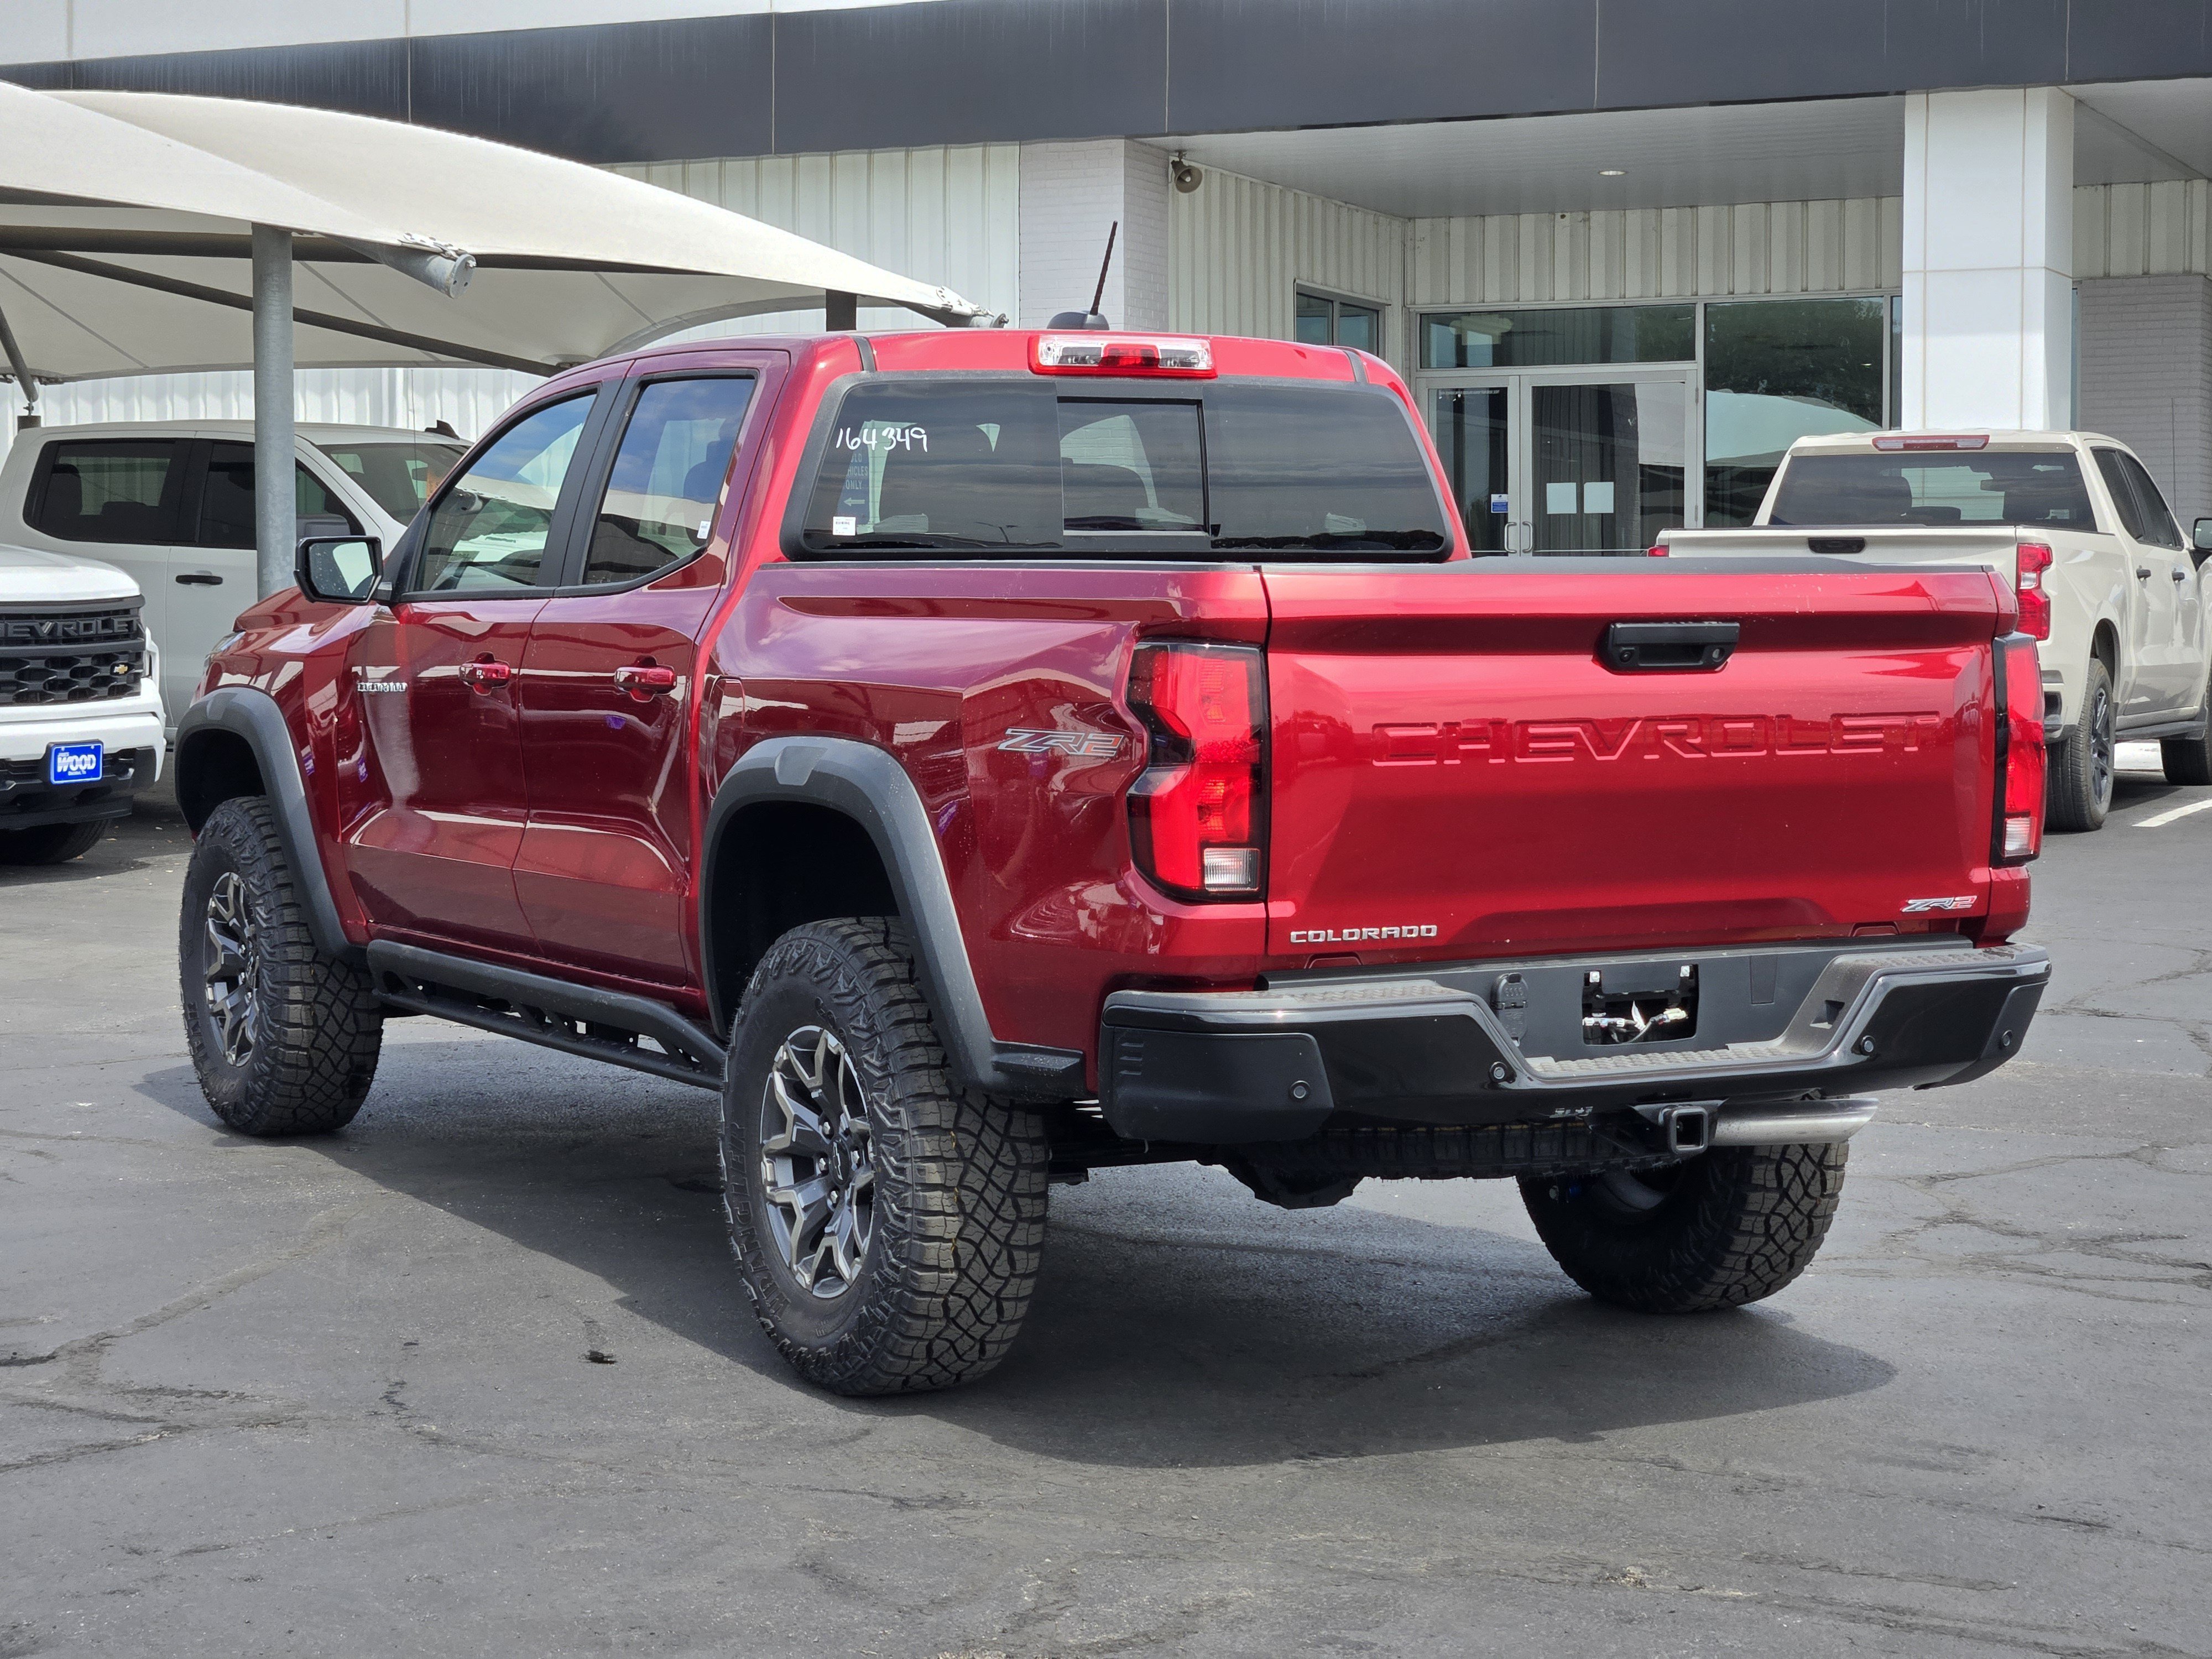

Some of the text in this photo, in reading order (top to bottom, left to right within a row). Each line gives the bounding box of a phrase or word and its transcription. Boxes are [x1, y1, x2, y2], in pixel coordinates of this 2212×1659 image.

[836, 427, 928, 452] 164349
[845, 479, 862, 490] ONLY
[997, 728, 1125, 757] ZR2
[1372, 711, 1940, 765] CHEVROLET
[57, 754, 96, 773] WOOD
[1901, 895, 1978, 912] ZR2
[1290, 925, 1437, 942] COLORADO
